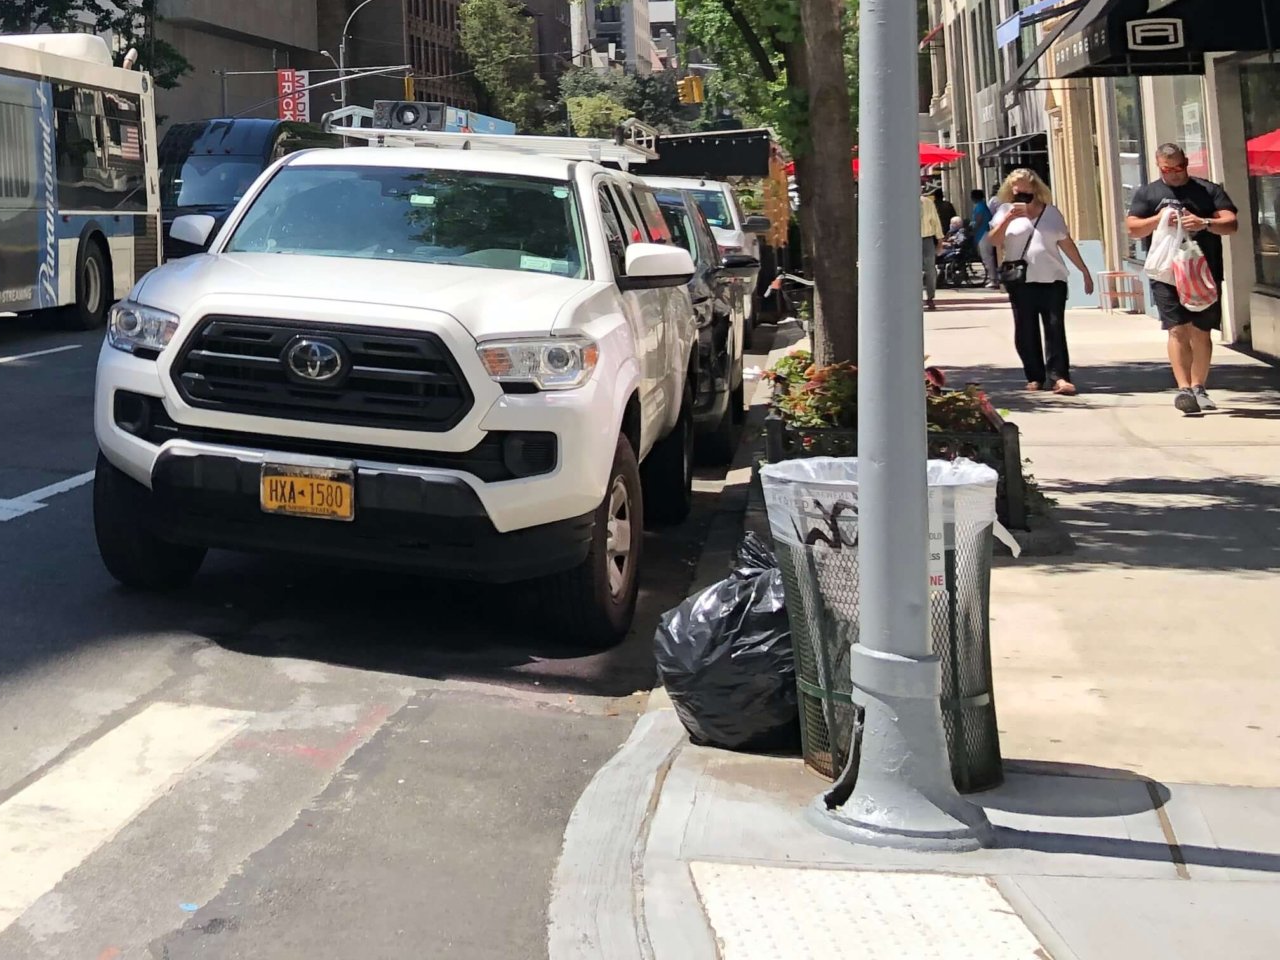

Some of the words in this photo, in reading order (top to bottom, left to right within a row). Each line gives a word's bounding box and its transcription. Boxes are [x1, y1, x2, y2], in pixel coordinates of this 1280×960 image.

[281, 71, 294, 121] FRICK
[2, 288, 32, 303] STREAMING
[269, 479, 296, 504] HXA
[309, 483, 343, 508] 1580
[929, 575, 944, 586] NE
